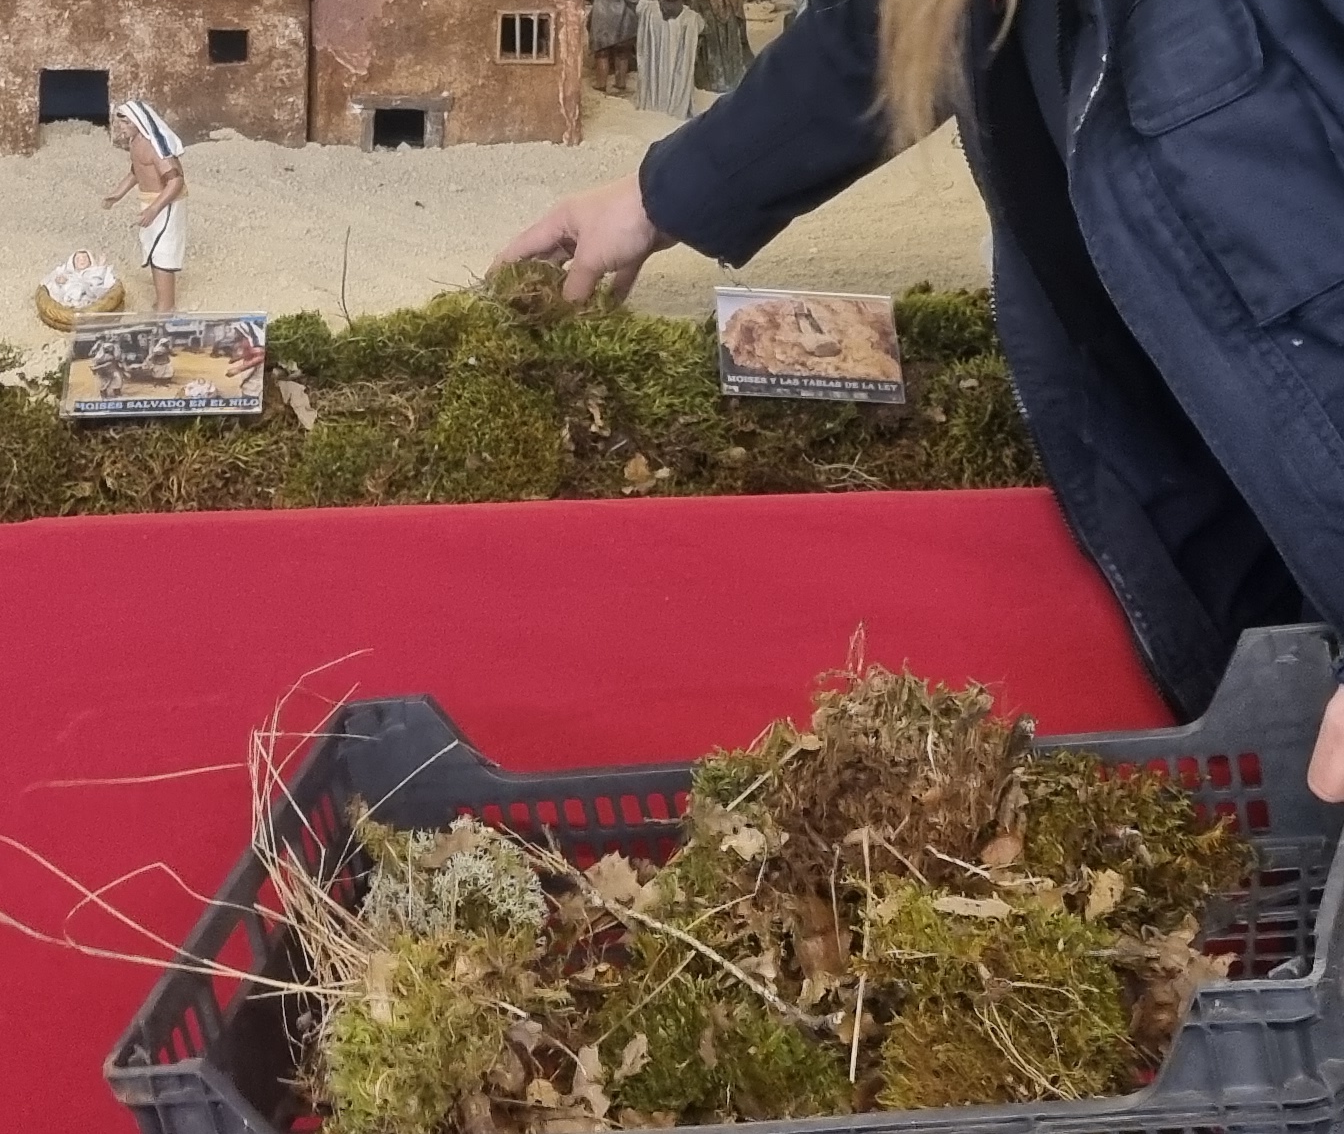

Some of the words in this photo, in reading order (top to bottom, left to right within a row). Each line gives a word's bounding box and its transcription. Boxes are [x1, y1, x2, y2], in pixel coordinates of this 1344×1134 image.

[727, 374, 768, 384] MOISES
[769, 377, 777, 385] Y
[779, 377, 800, 386] LAS
[801, 378, 842, 388] TABLAS
[844, 381, 859, 389] DE
[861, 382, 876, 390] LA
[877, 383, 898, 392] LEY
[126, 399, 186, 409] SALVADO
[189, 399, 207, 408] EN
[210, 398, 227, 407] EL
[229, 398, 259, 407] NILO
